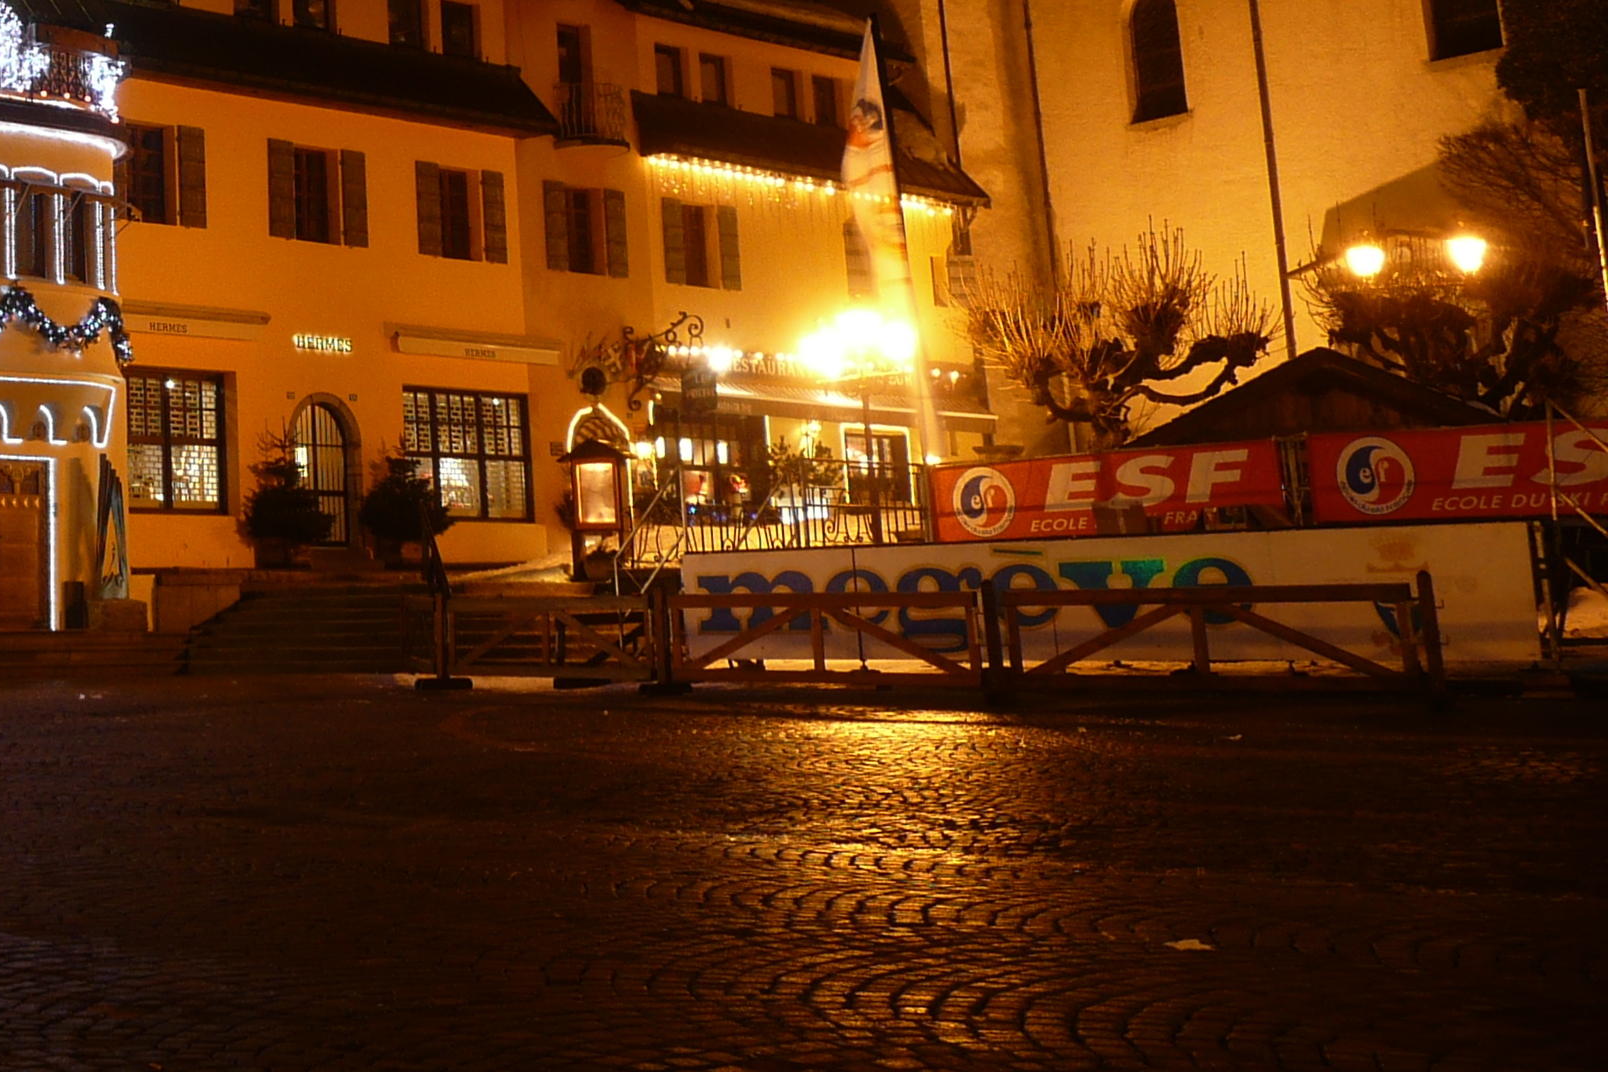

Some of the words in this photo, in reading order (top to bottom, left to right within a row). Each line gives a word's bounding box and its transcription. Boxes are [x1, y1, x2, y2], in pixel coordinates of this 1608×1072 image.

[149, 322, 188, 333] HERMES
[296, 335, 353, 353] HERMES
[1044, 449, 1249, 512] ESF
[1430, 494, 1503, 511] ECOLE
[1510, 492, 1546, 508] DU
[1030, 516, 1088, 533] ECOLE
